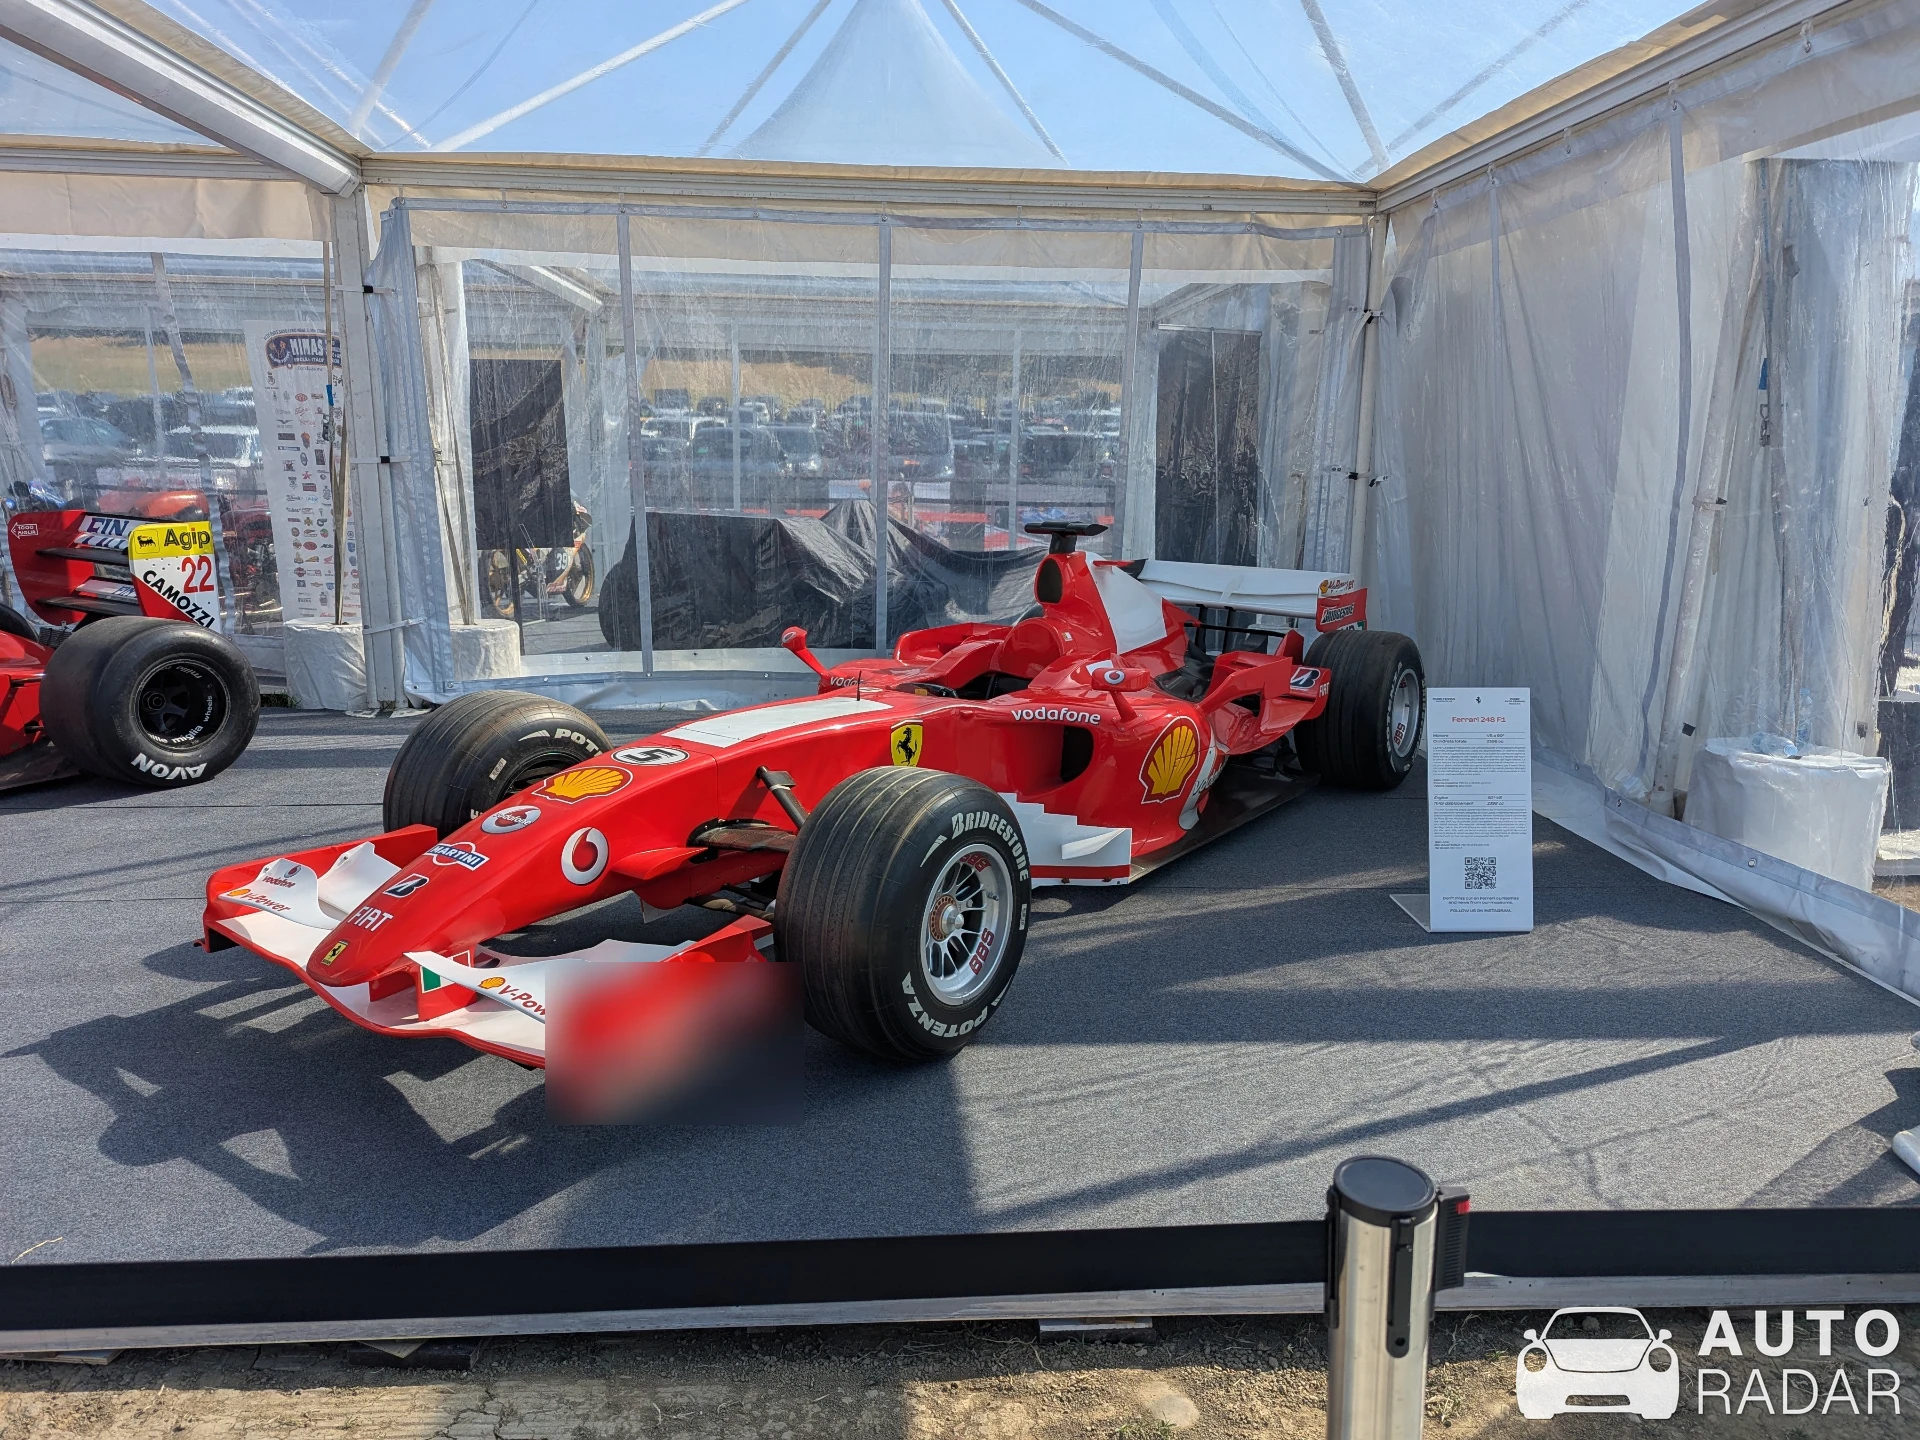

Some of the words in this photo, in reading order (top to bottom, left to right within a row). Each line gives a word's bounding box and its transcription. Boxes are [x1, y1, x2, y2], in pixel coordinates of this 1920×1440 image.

[163, 527, 211, 550] Agip
[181, 555, 215, 594] 22
[556, 553, 568, 571] 39
[143, 570, 215, 628] CAMOZZI
[203, 695, 213, 722] wheels
[1011, 707, 1101, 725] vodafone
[171, 725, 204, 744] miglia
[130, 752, 208, 780] AVON
[430, 844, 485, 867] MARTINI
[951, 810, 1030, 882] BRIDGESTONE
[347, 906, 394, 932] FIAT
[969, 928, 995, 975] BBS
[498, 984, 546, 1015] V-Pow
[901, 971, 989, 1038] POTENZA
